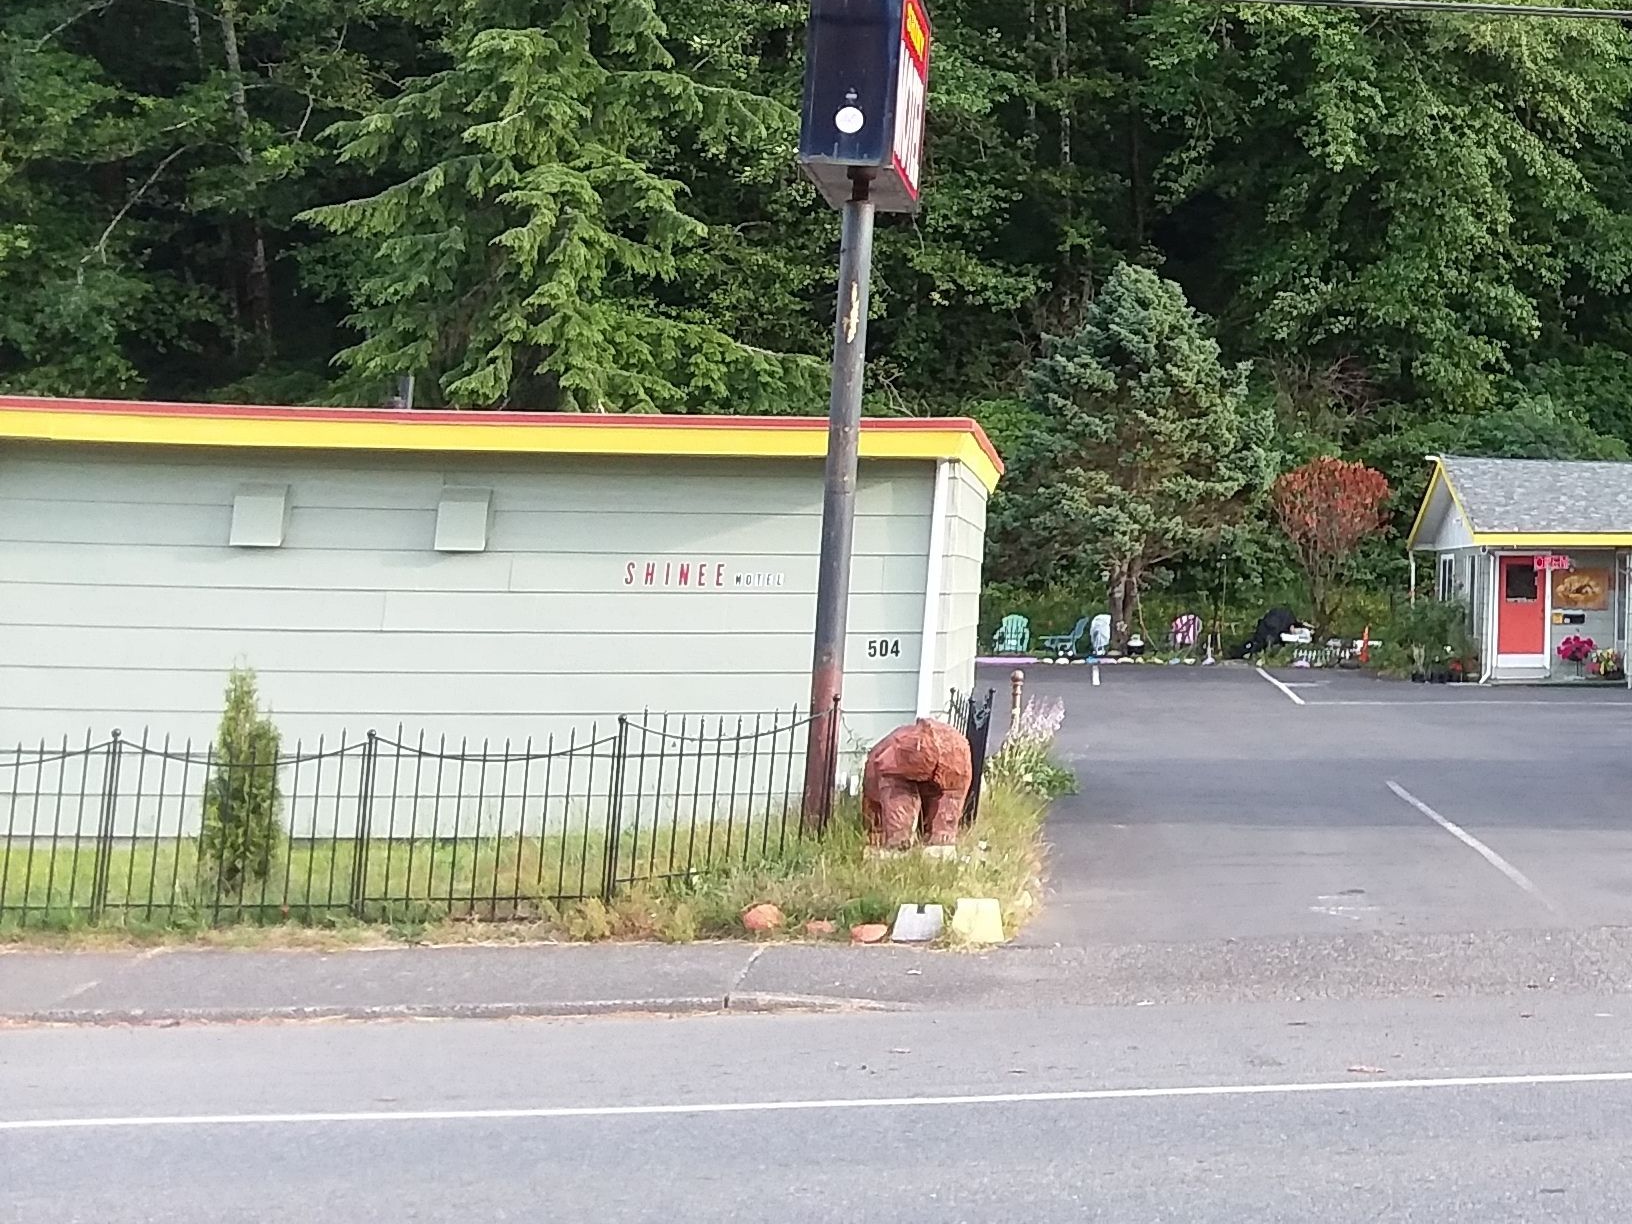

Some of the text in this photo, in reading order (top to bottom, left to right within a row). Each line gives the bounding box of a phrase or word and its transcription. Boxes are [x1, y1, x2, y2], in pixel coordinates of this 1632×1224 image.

[1536, 556, 1569, 569] OPEN
[624, 561, 783, 587] SHINEE MOTEL
[867, 639, 901, 658] 504
